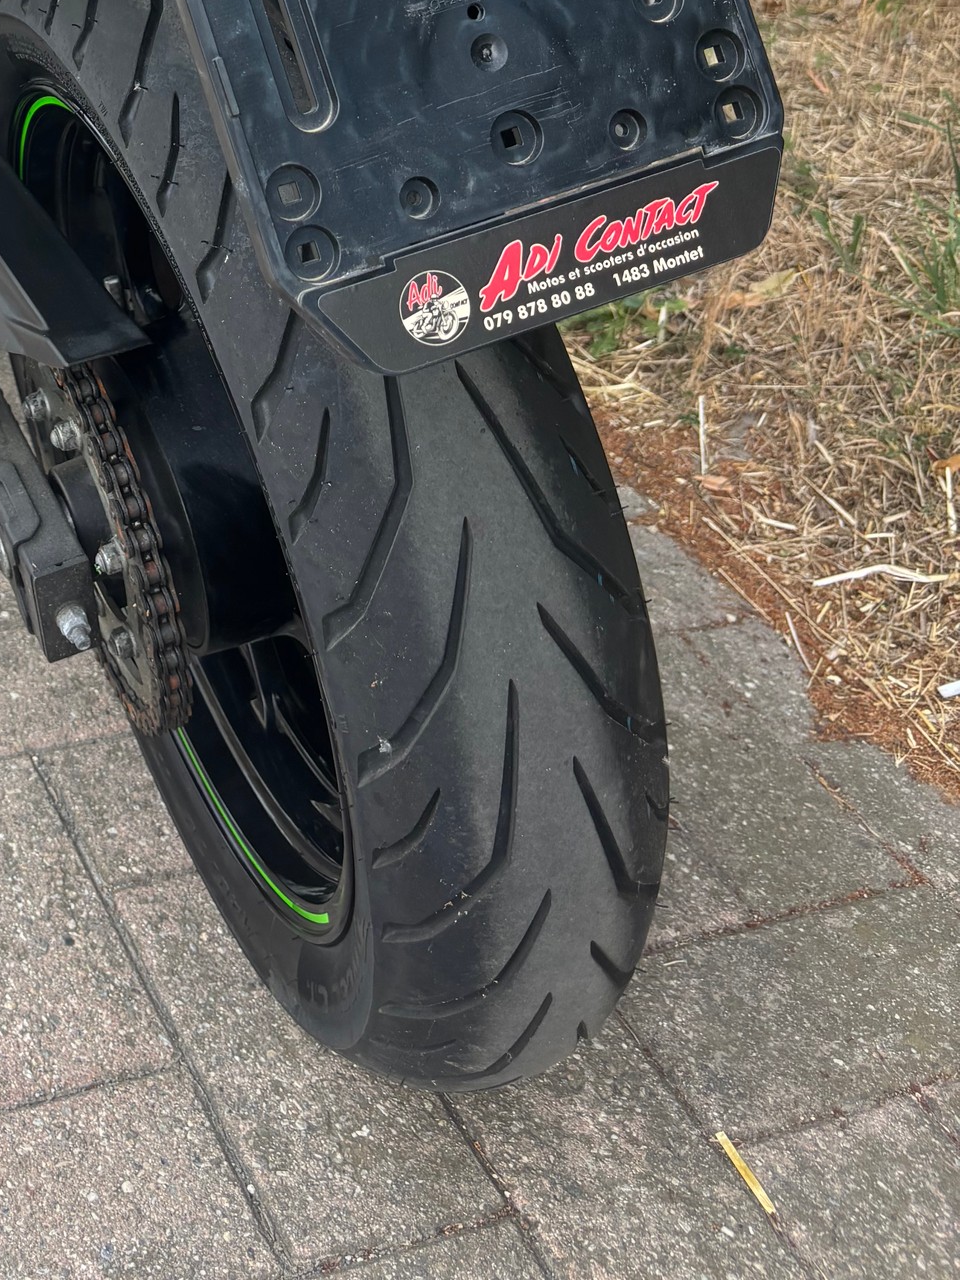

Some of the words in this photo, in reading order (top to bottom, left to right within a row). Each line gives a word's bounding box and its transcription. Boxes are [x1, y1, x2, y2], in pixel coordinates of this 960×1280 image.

[574, 181, 719, 263] CONTACT
[406, 272, 442, 311] Adi
[483, 310, 513, 331] 079
[517, 299, 547, 320] 878
[551, 290, 571, 308] 80
[574, 282, 595, 300] 88
[612, 263, 650, 287] 1483
[652, 245, 704, 274] Montet
[527, 275, 565, 294] Motos
[568, 268, 580, 280] et
[583, 251, 634, 275] scooters
[636, 229, 700, 257] d'occasion
